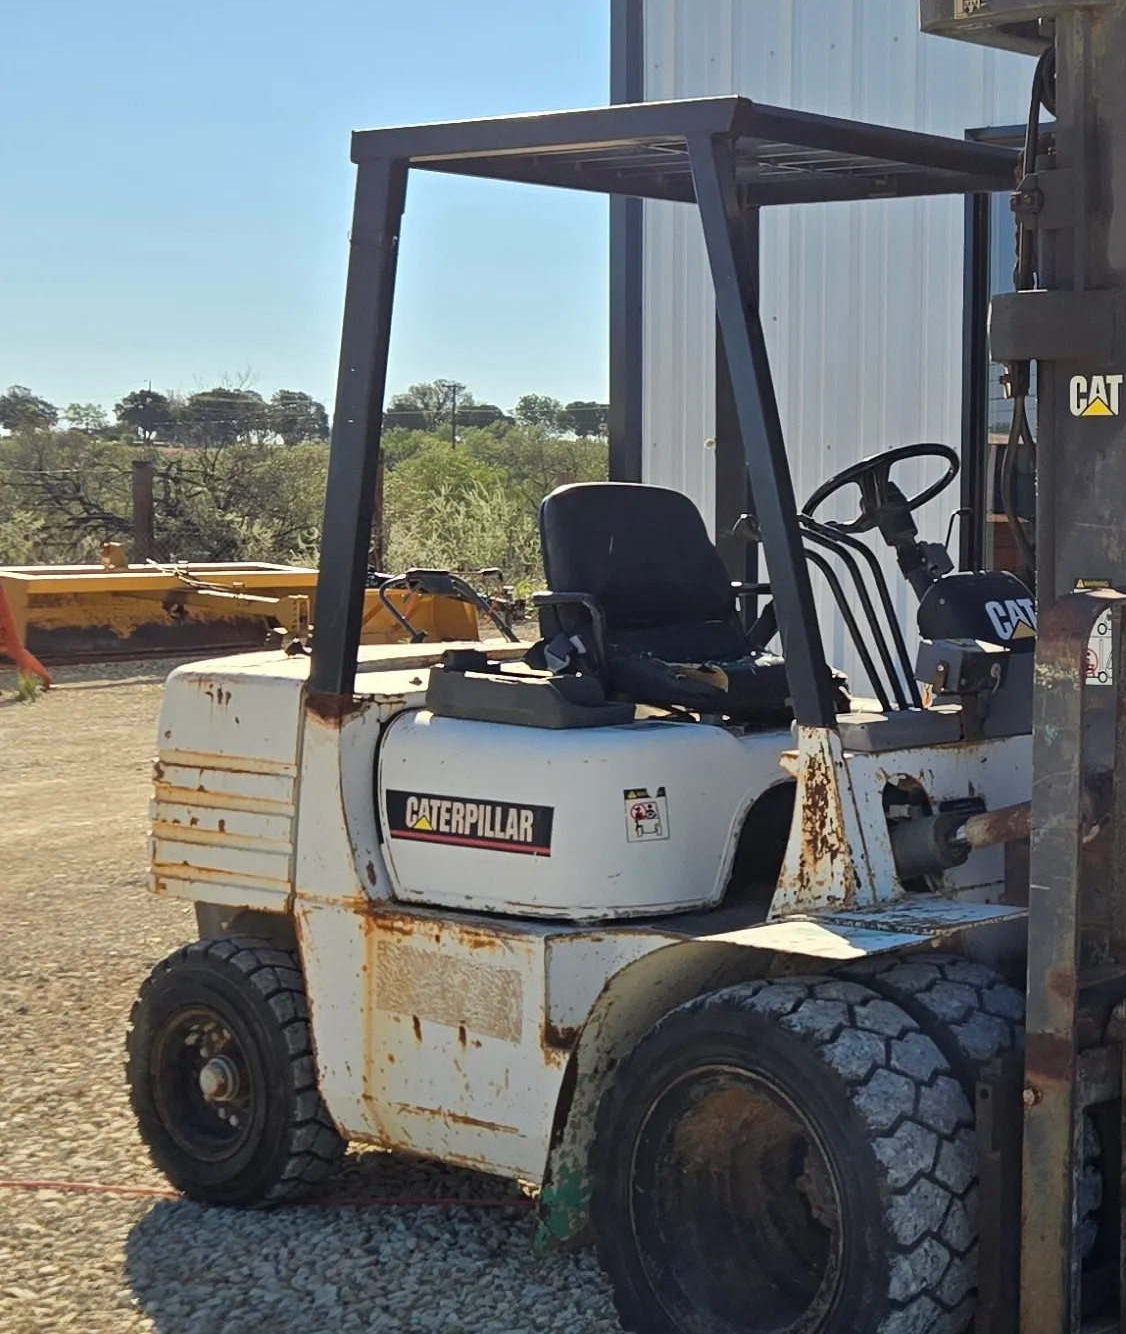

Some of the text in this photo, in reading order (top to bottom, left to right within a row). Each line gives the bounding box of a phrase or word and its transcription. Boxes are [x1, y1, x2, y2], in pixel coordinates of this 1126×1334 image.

[1070, 374, 1123, 416] CAT
[985, 598, 1037, 641] CAT
[405, 796, 534, 843] CATERPILLAR
